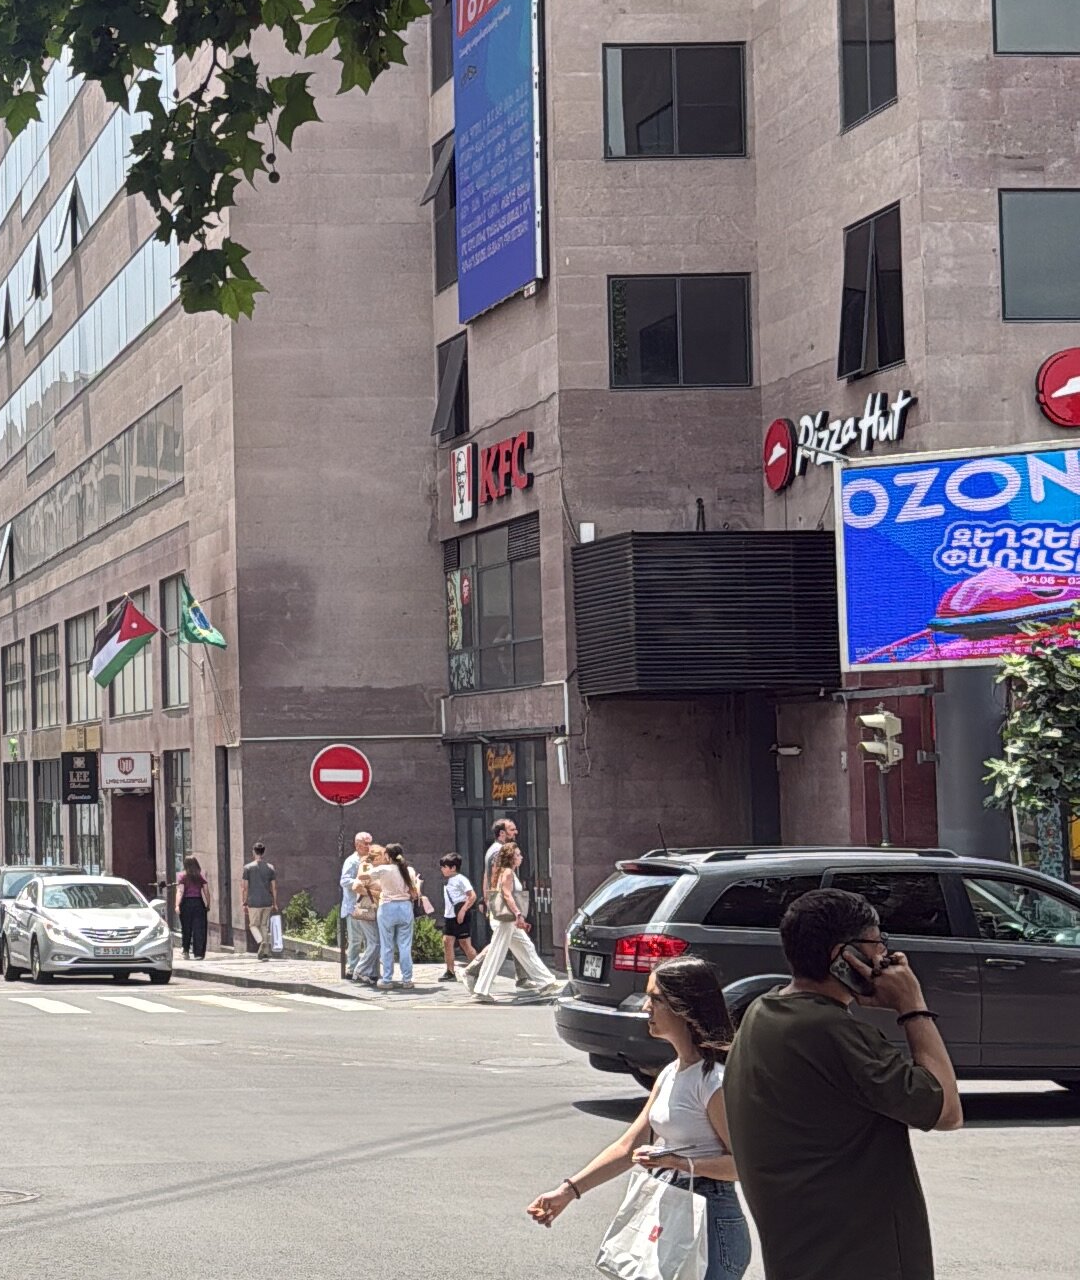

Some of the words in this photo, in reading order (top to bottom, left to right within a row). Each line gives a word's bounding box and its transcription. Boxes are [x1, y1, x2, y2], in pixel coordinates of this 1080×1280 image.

[479, 431, 530, 505] KFC
[795, 410, 858, 476] Pizza
[858, 389, 912, 452] Hut
[841, 448, 1080, 529] OZON
